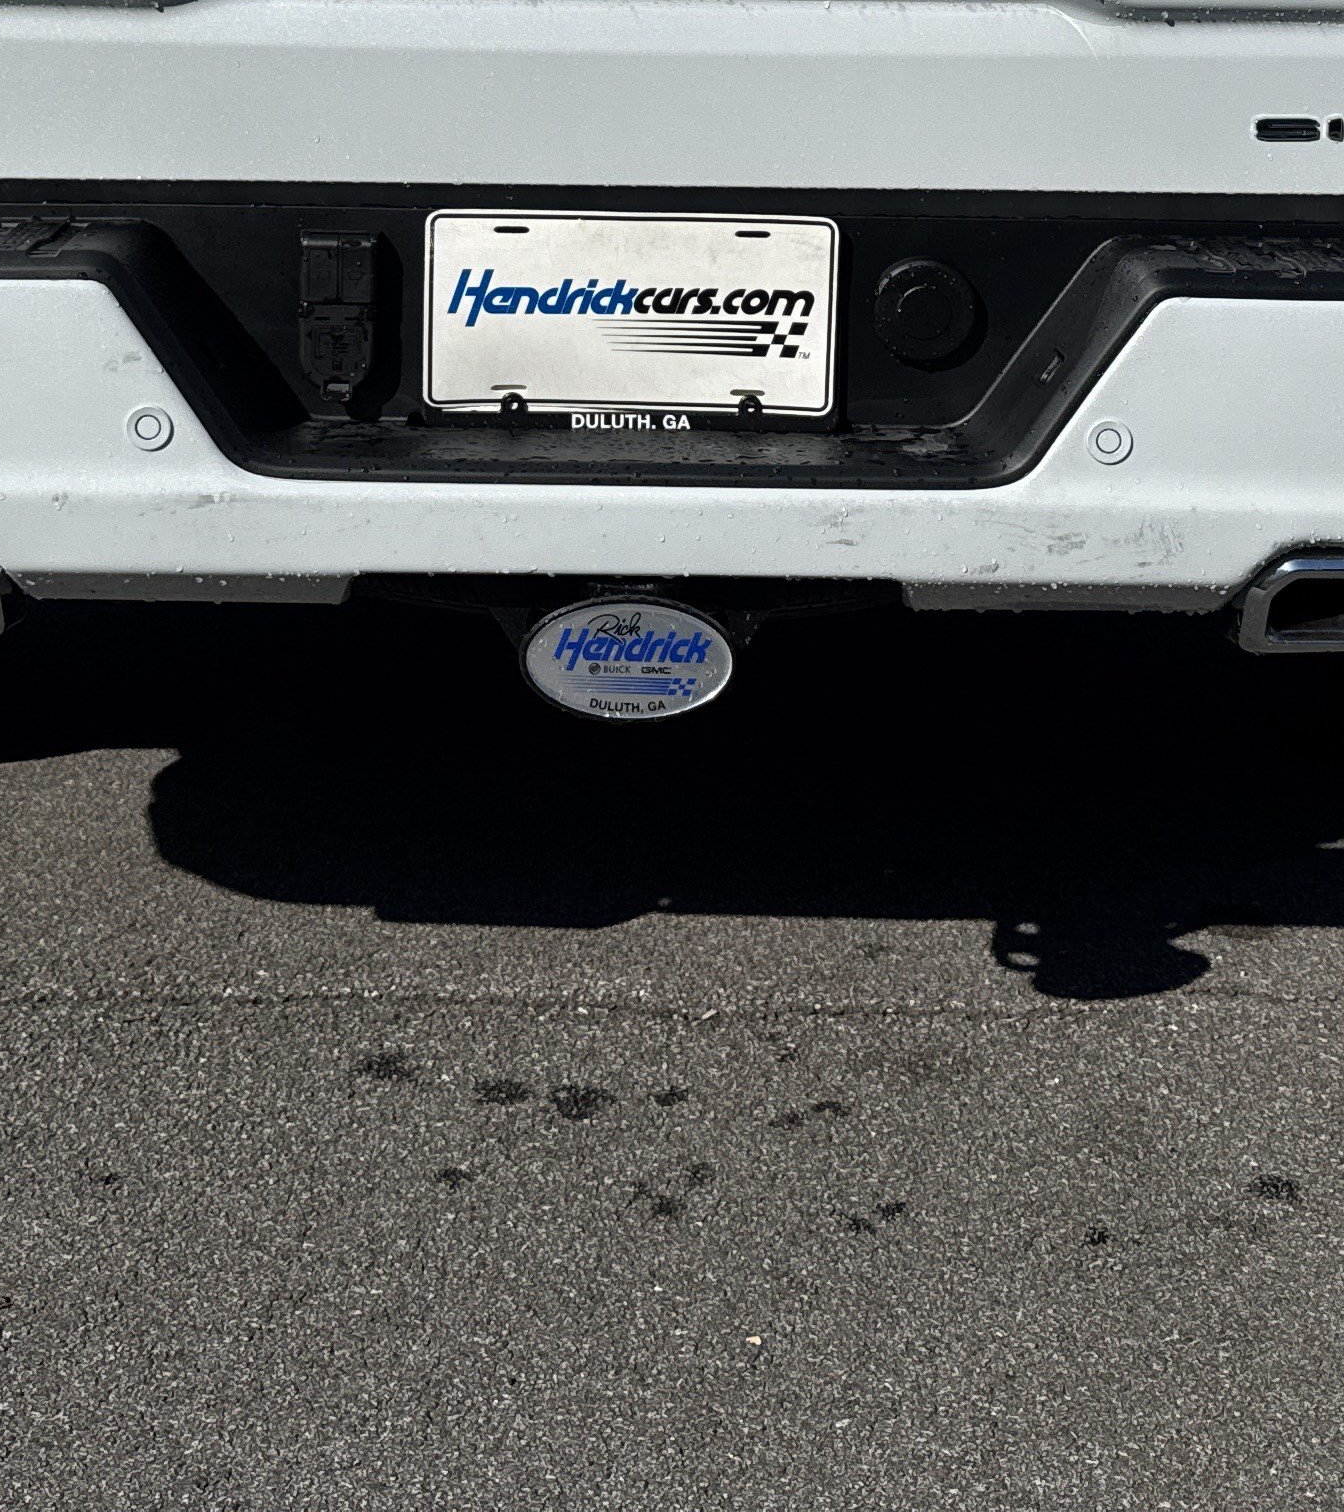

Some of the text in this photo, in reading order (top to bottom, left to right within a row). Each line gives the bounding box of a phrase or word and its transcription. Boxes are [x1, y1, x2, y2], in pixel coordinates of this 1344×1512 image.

[447, 268, 815, 328] Hendrickcars.com
[662, 414, 691, 430] GA
[587, 611, 642, 644] Rick
[554, 627, 713, 671] Hendrick
[603, 663, 672, 675] BUICK GMC
[647, 700, 666, 712] GA
